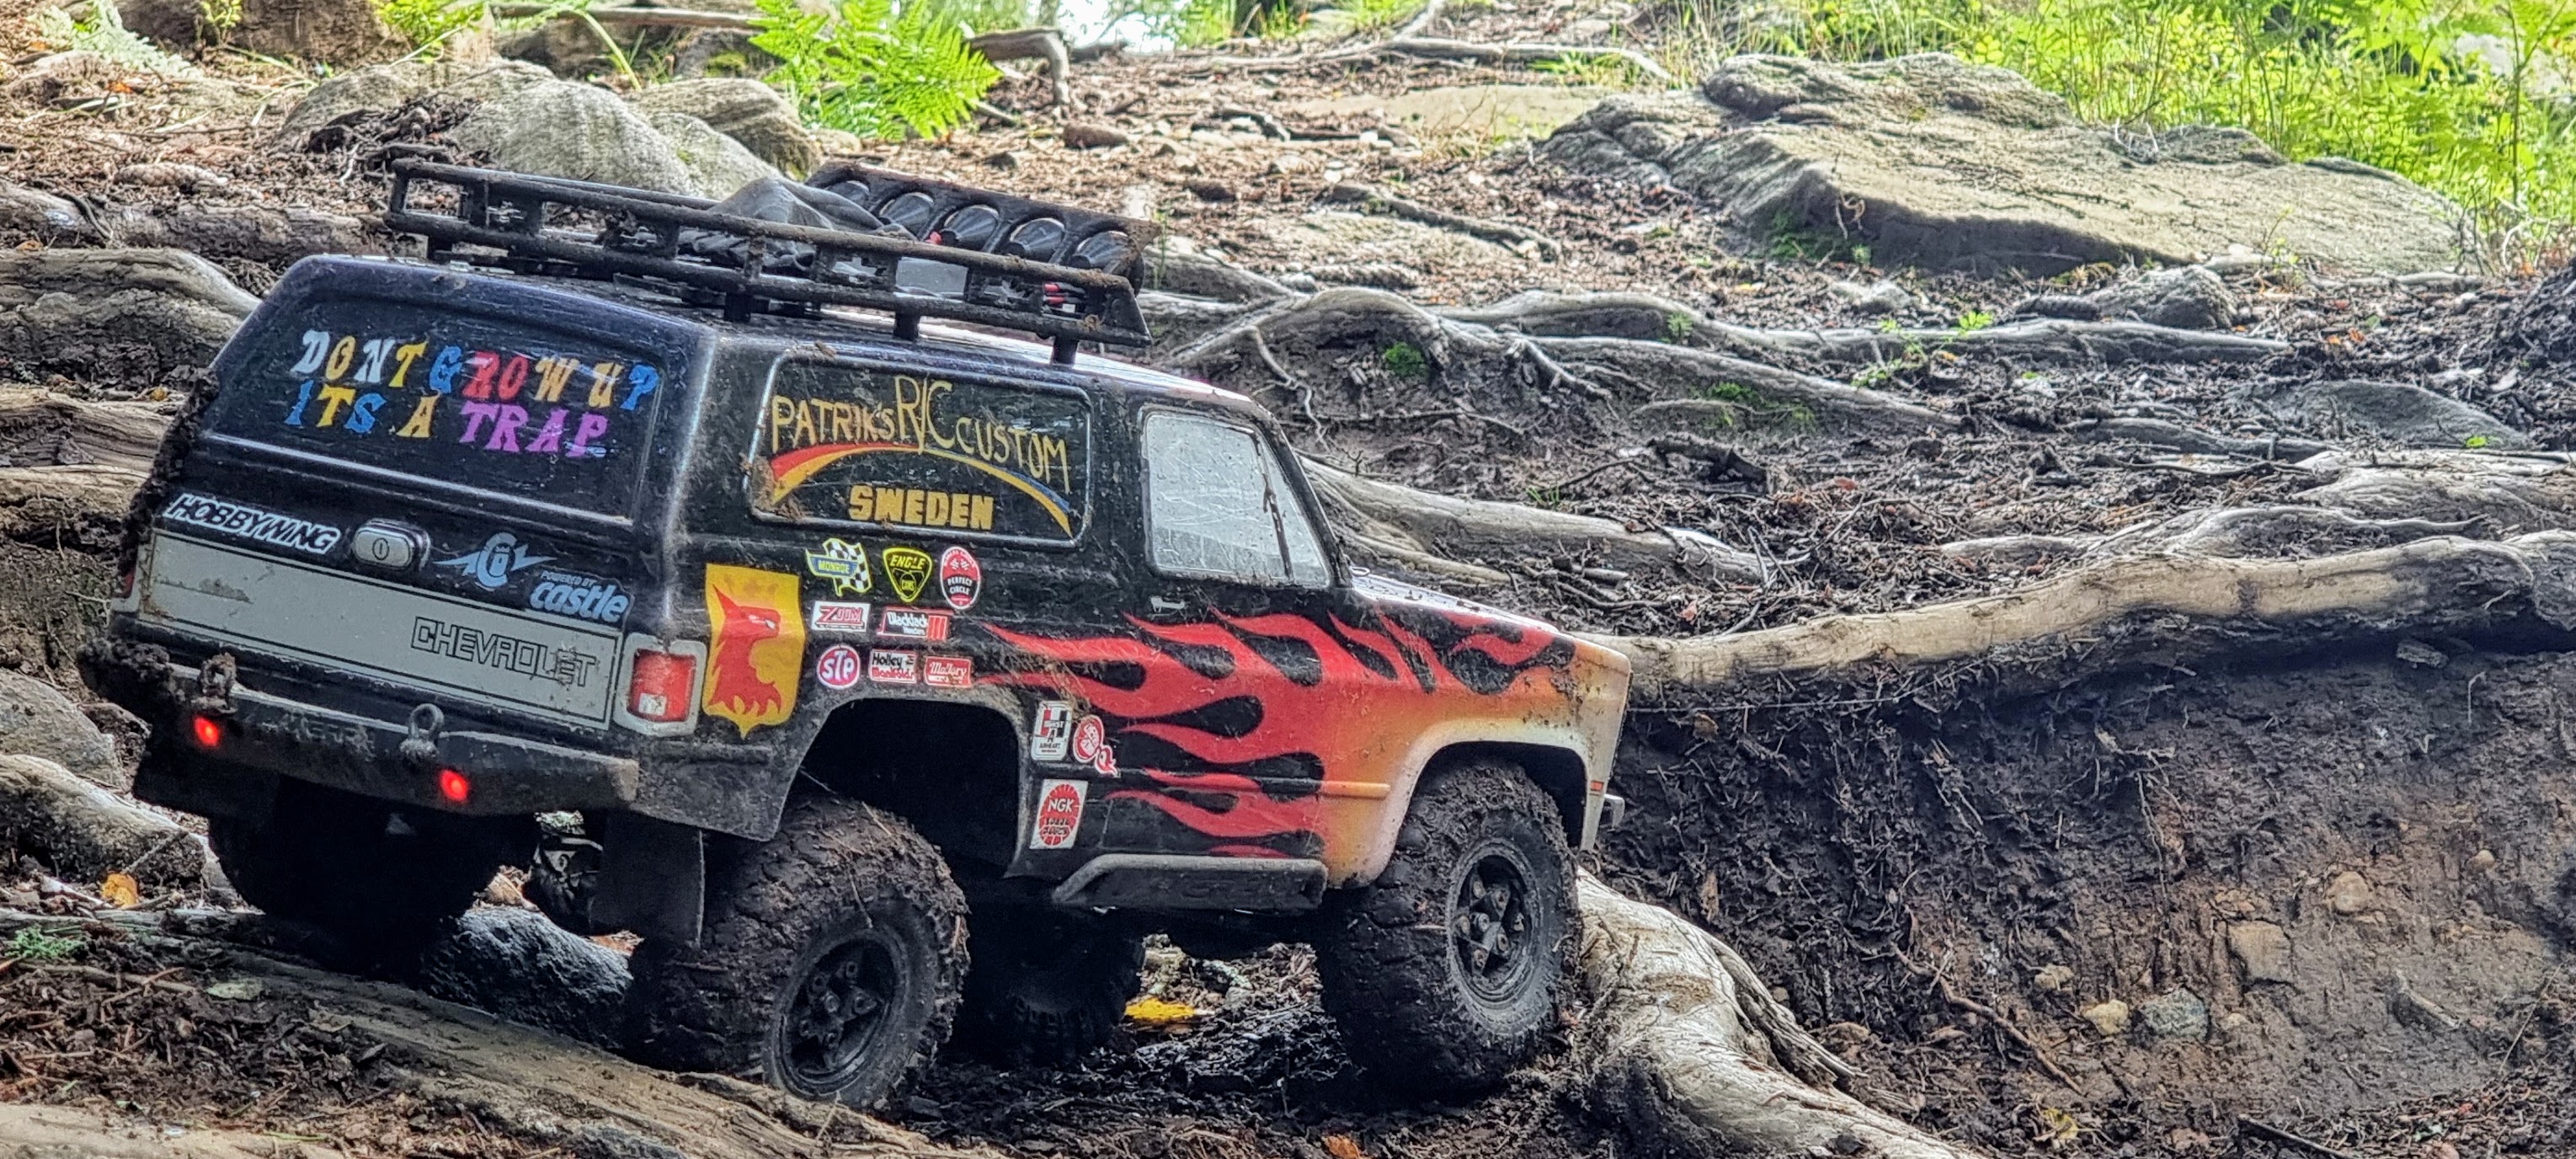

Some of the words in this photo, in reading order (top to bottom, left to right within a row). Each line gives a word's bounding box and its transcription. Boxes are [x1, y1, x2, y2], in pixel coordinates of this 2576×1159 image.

[289, 329, 428, 387] DONT
[429, 345, 576, 403] GROW
[587, 361, 659, 411] UP
[284, 381, 387, 435] ITS
[396, 393, 441, 438] A
[459, 400, 609, 458] TRAP
[955, 416, 1071, 494] CUSTOM
[849, 484, 995, 531] SWEDEN
[162, 493, 341, 554] HOBBYWING
[818, 559, 851, 574] MONROE
[888, 554, 926, 570] ENGLE
[540, 569, 583, 587] POWERED
[947, 576, 973, 586] PERFECT
[949, 586, 970, 596] CIRCLE
[530, 581, 631, 624] castle
[816, 605, 864, 623] ZOOM
[411, 616, 597, 687] CHEVROLET
[872, 652, 904, 669] Holley
[822, 649, 856, 682] STP
[929, 661, 968, 678] Mallory
[1048, 797, 1075, 814] NGK
